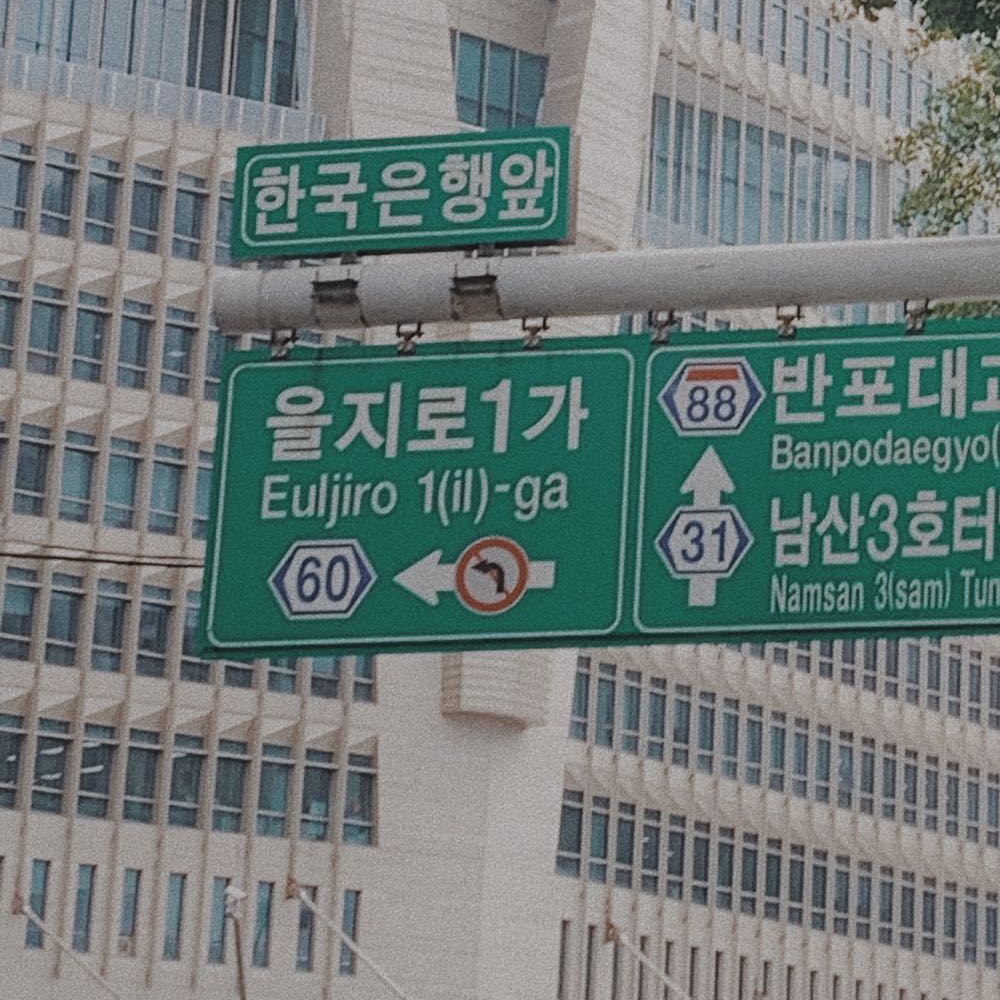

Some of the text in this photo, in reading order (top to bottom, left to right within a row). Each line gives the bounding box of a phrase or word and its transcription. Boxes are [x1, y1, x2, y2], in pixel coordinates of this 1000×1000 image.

[252, 148, 554, 236] 한국은행앞
[265, 376, 589, 462] 을지로1가
[686, 384, 737, 423] 88
[261, 467, 569, 529] Euljiro 1(il)-ga
[680, 519, 727, 565] 31
[298, 554, 352, 604] 60
[770, 573, 865, 614] Namsan
[873, 569, 952, 612] 3(sam)
